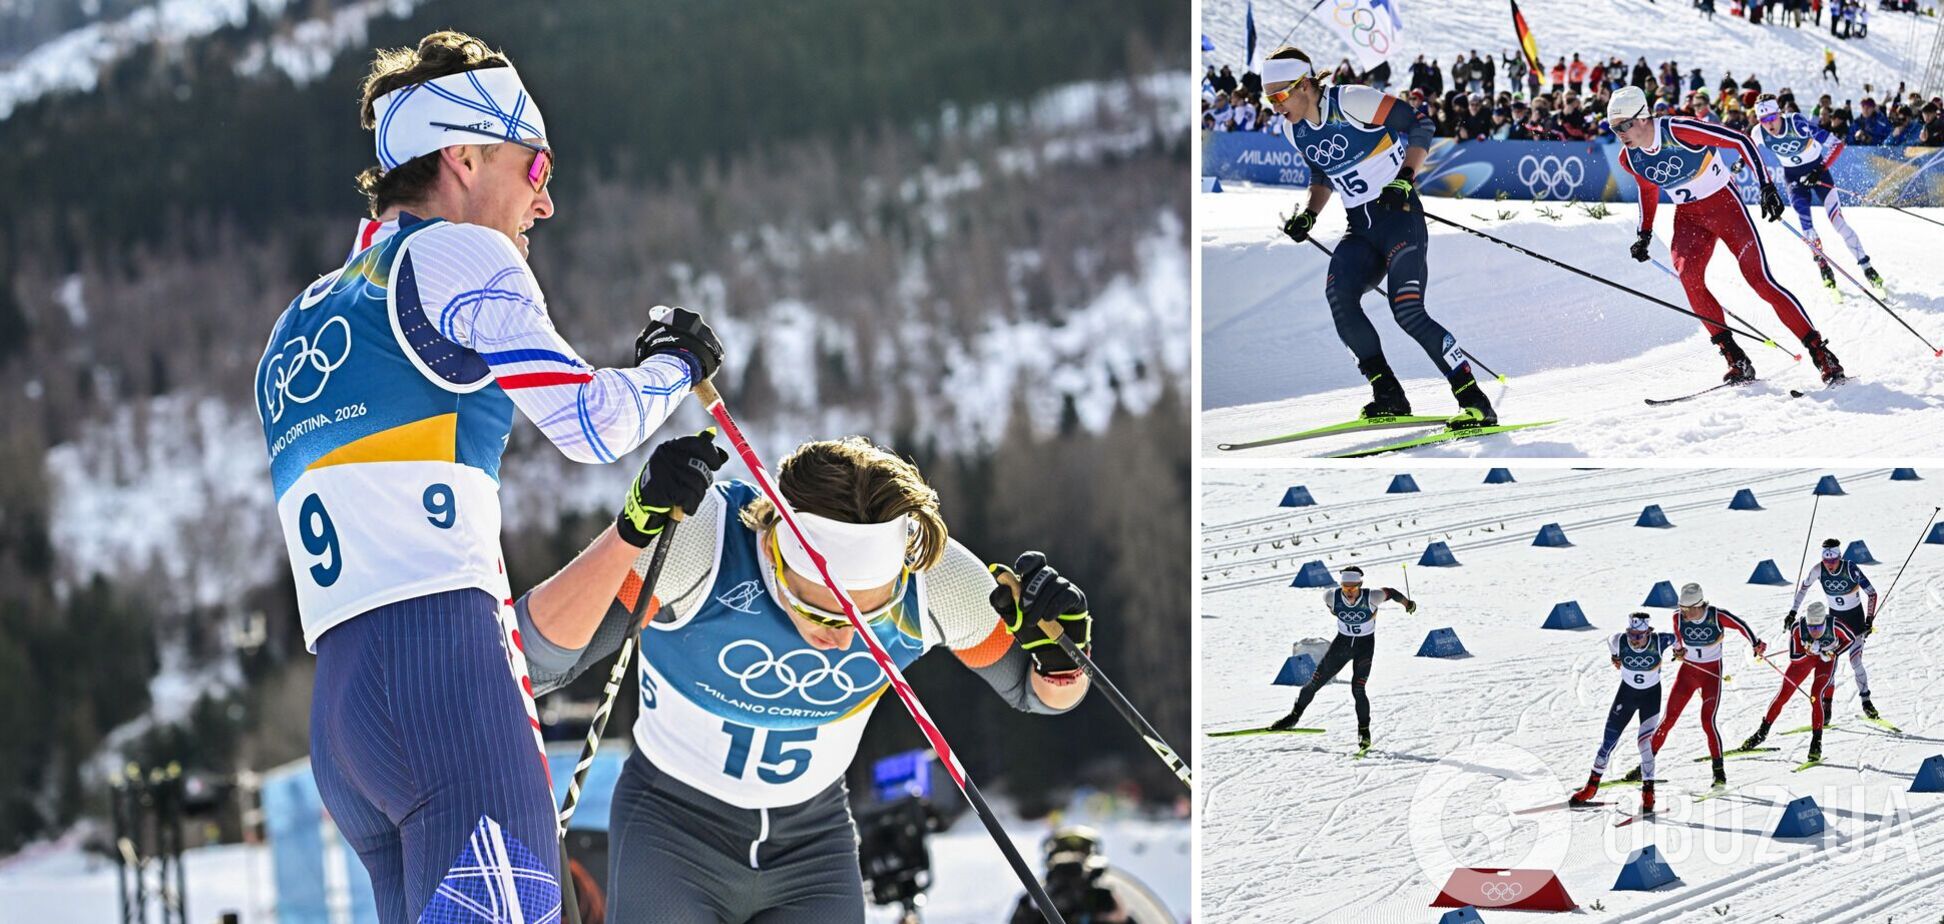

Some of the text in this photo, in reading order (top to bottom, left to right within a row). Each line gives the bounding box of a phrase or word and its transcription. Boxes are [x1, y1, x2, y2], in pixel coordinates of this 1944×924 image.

[1236, 150, 1292, 167] MILANO
[1389, 144, 1405, 166] 15
[1279, 168, 1305, 183] 2026
[1712, 163, 1721, 176] 2
[1334, 170, 1368, 197] 15
[1449, 347, 1463, 362] 15
[285, 413, 332, 444] CORTINA
[334, 402, 367, 422] 2026
[423, 483, 456, 530] 9
[299, 492, 343, 588] 9
[1835, 597, 1845, 606] 9
[1695, 648, 1702, 659] 1
[1633, 673, 1645, 684] 6
[641, 674, 658, 709] 5
[696, 681, 765, 713] MILANO
[721, 720, 819, 785] 15
